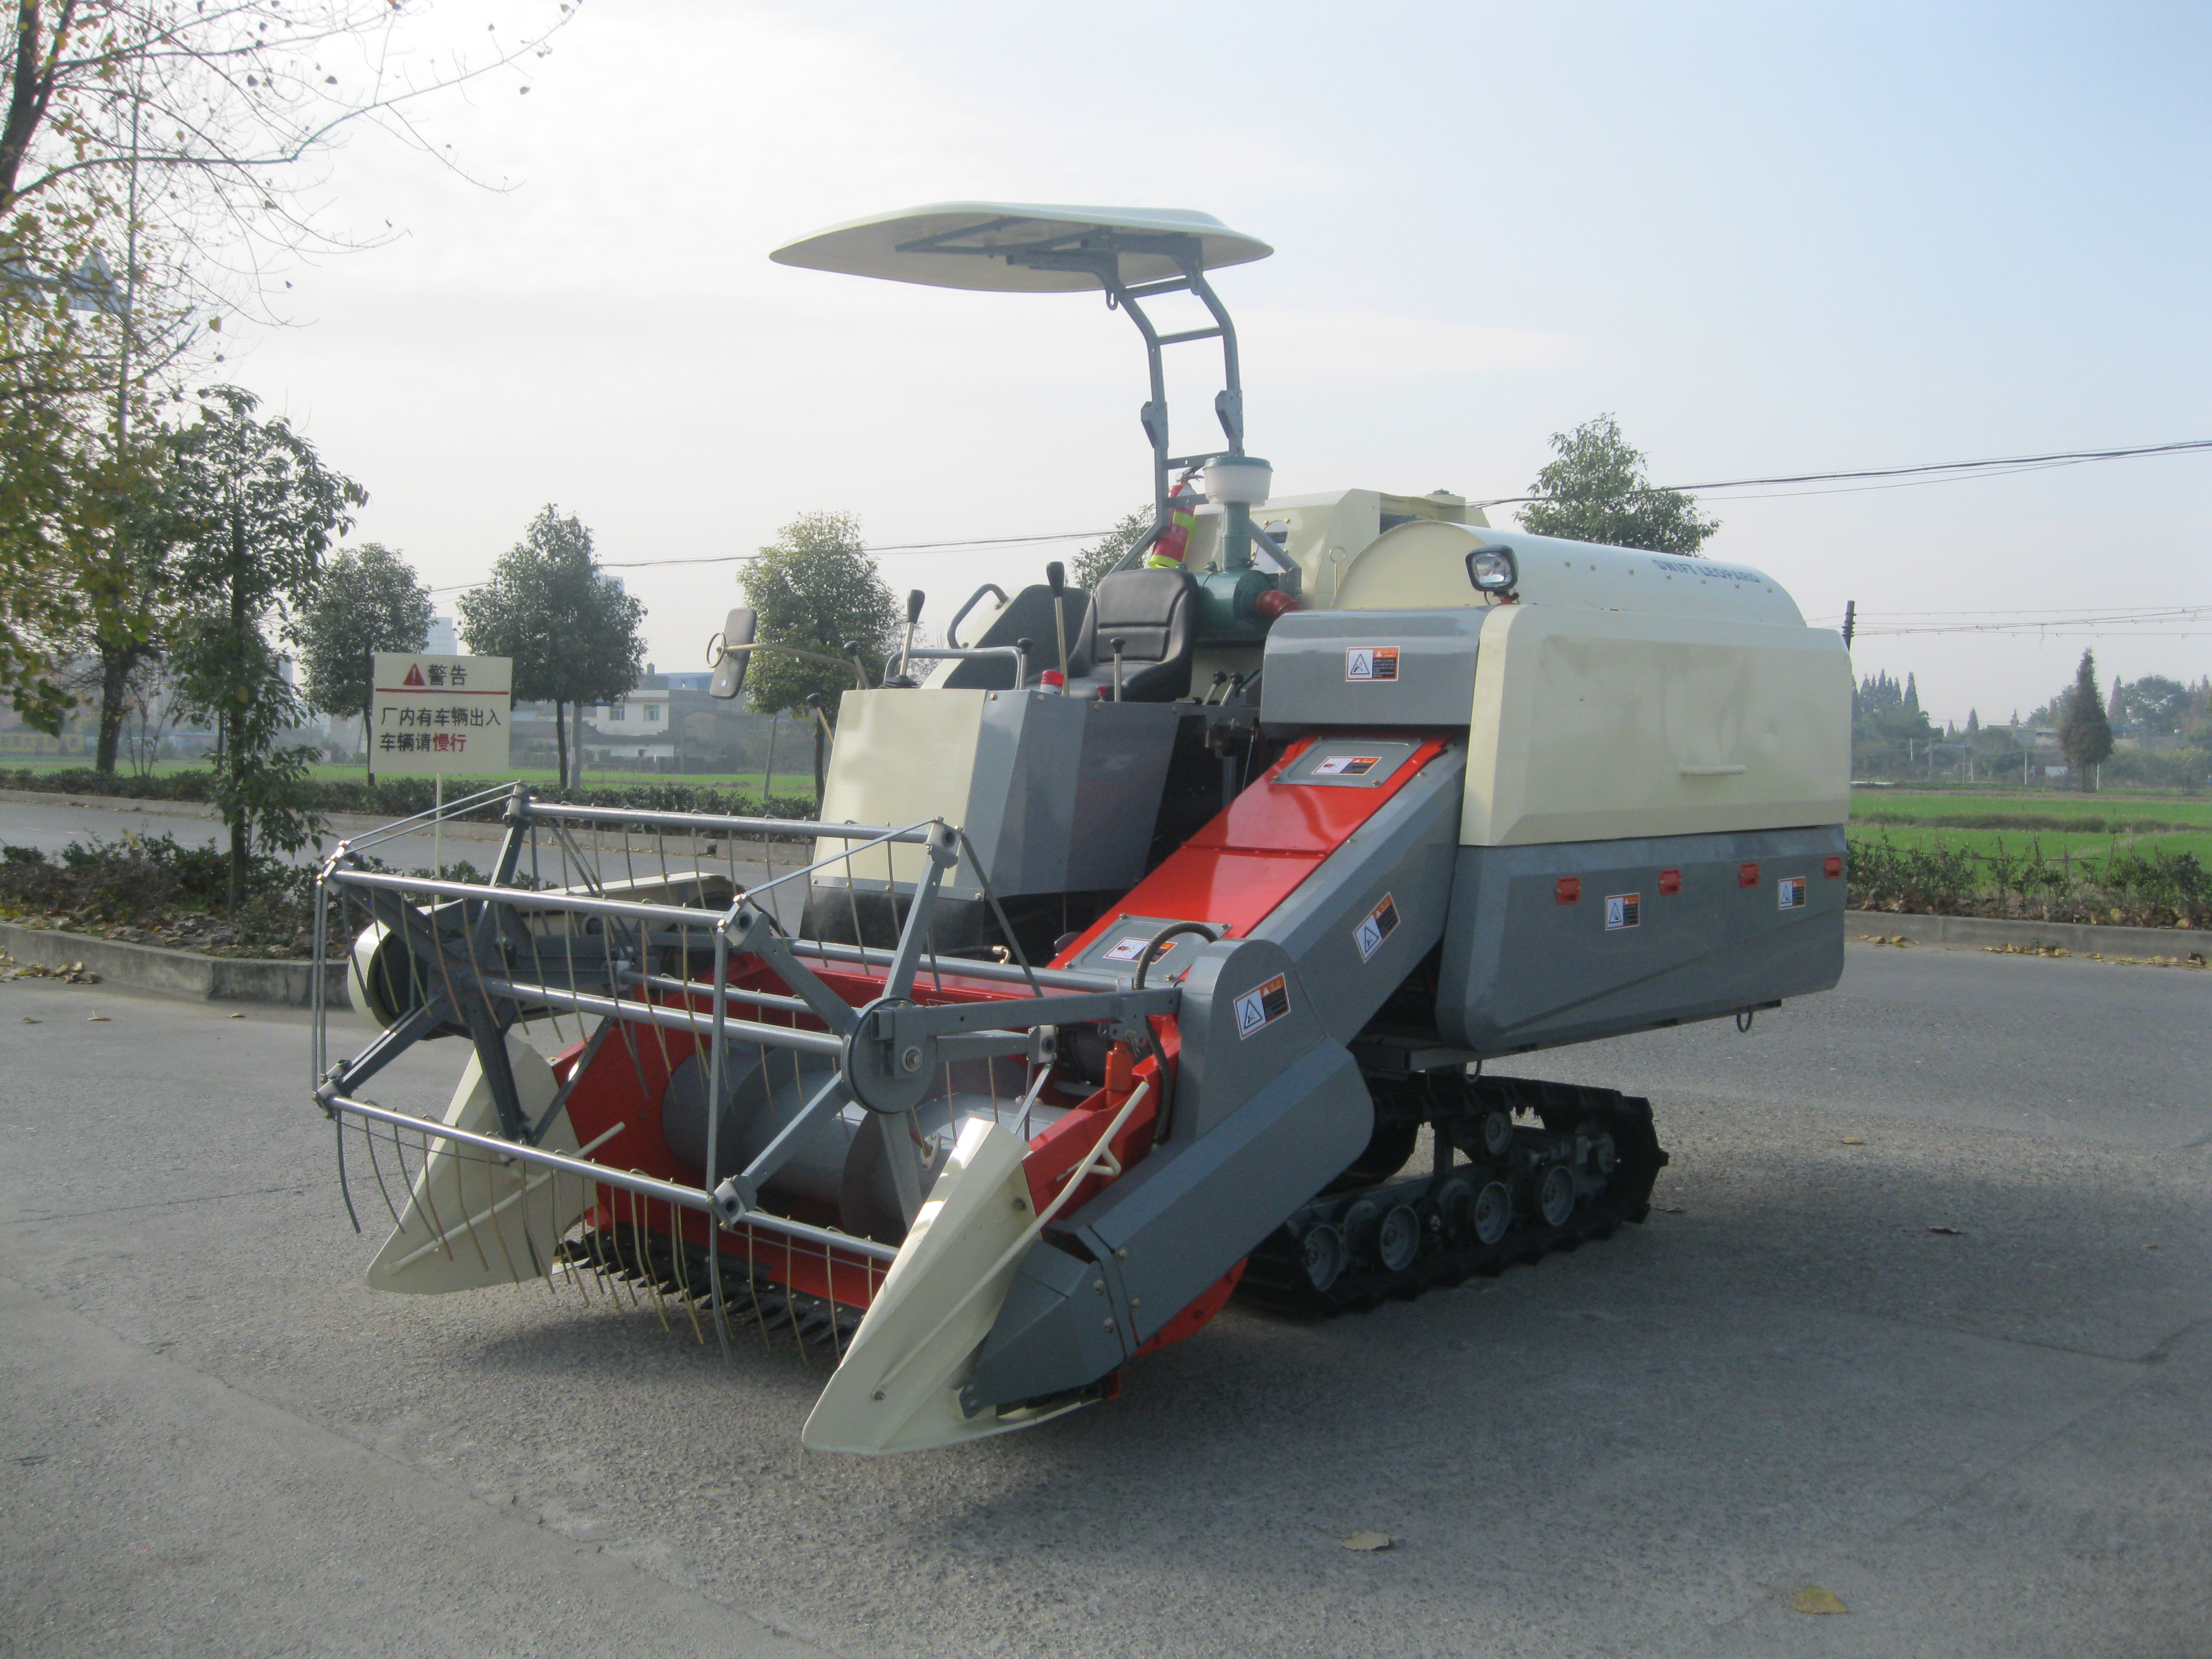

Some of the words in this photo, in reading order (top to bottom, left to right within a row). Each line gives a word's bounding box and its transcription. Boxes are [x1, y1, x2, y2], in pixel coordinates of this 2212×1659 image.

[1652, 559, 1698, 575] SWIFT
[1695, 565, 1761, 583] LEOPARD
[428, 664, 468, 686] 警告
[380, 706, 502, 728] 厂内有车辆出入
[379, 732, 467, 753] 车辆请慢行
